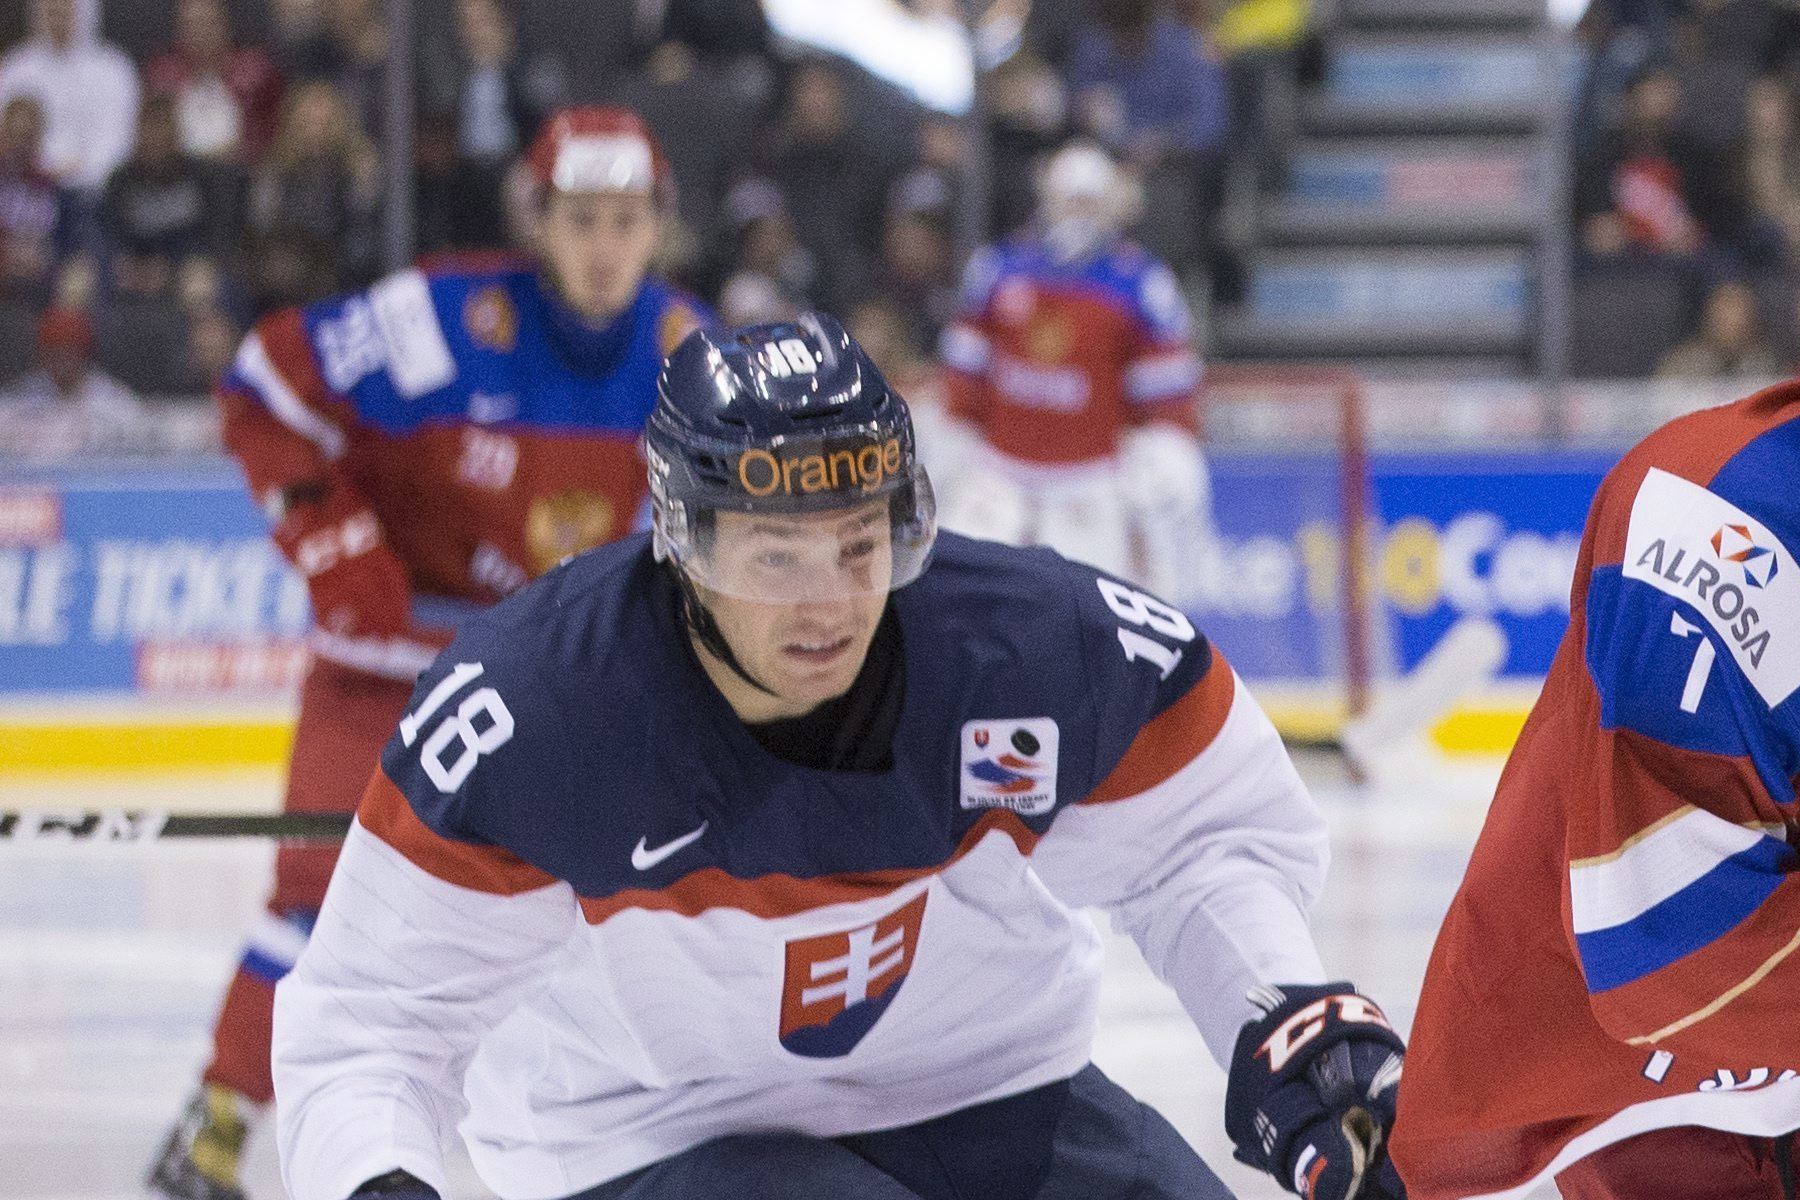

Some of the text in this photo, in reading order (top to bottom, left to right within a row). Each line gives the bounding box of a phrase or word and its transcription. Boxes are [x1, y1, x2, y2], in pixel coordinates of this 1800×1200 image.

[738, 438, 900, 497] Orange
[1095, 577, 1196, 681] 18
[1637, 538, 1772, 670] ALROSA
[398, 660, 516, 794] 18
